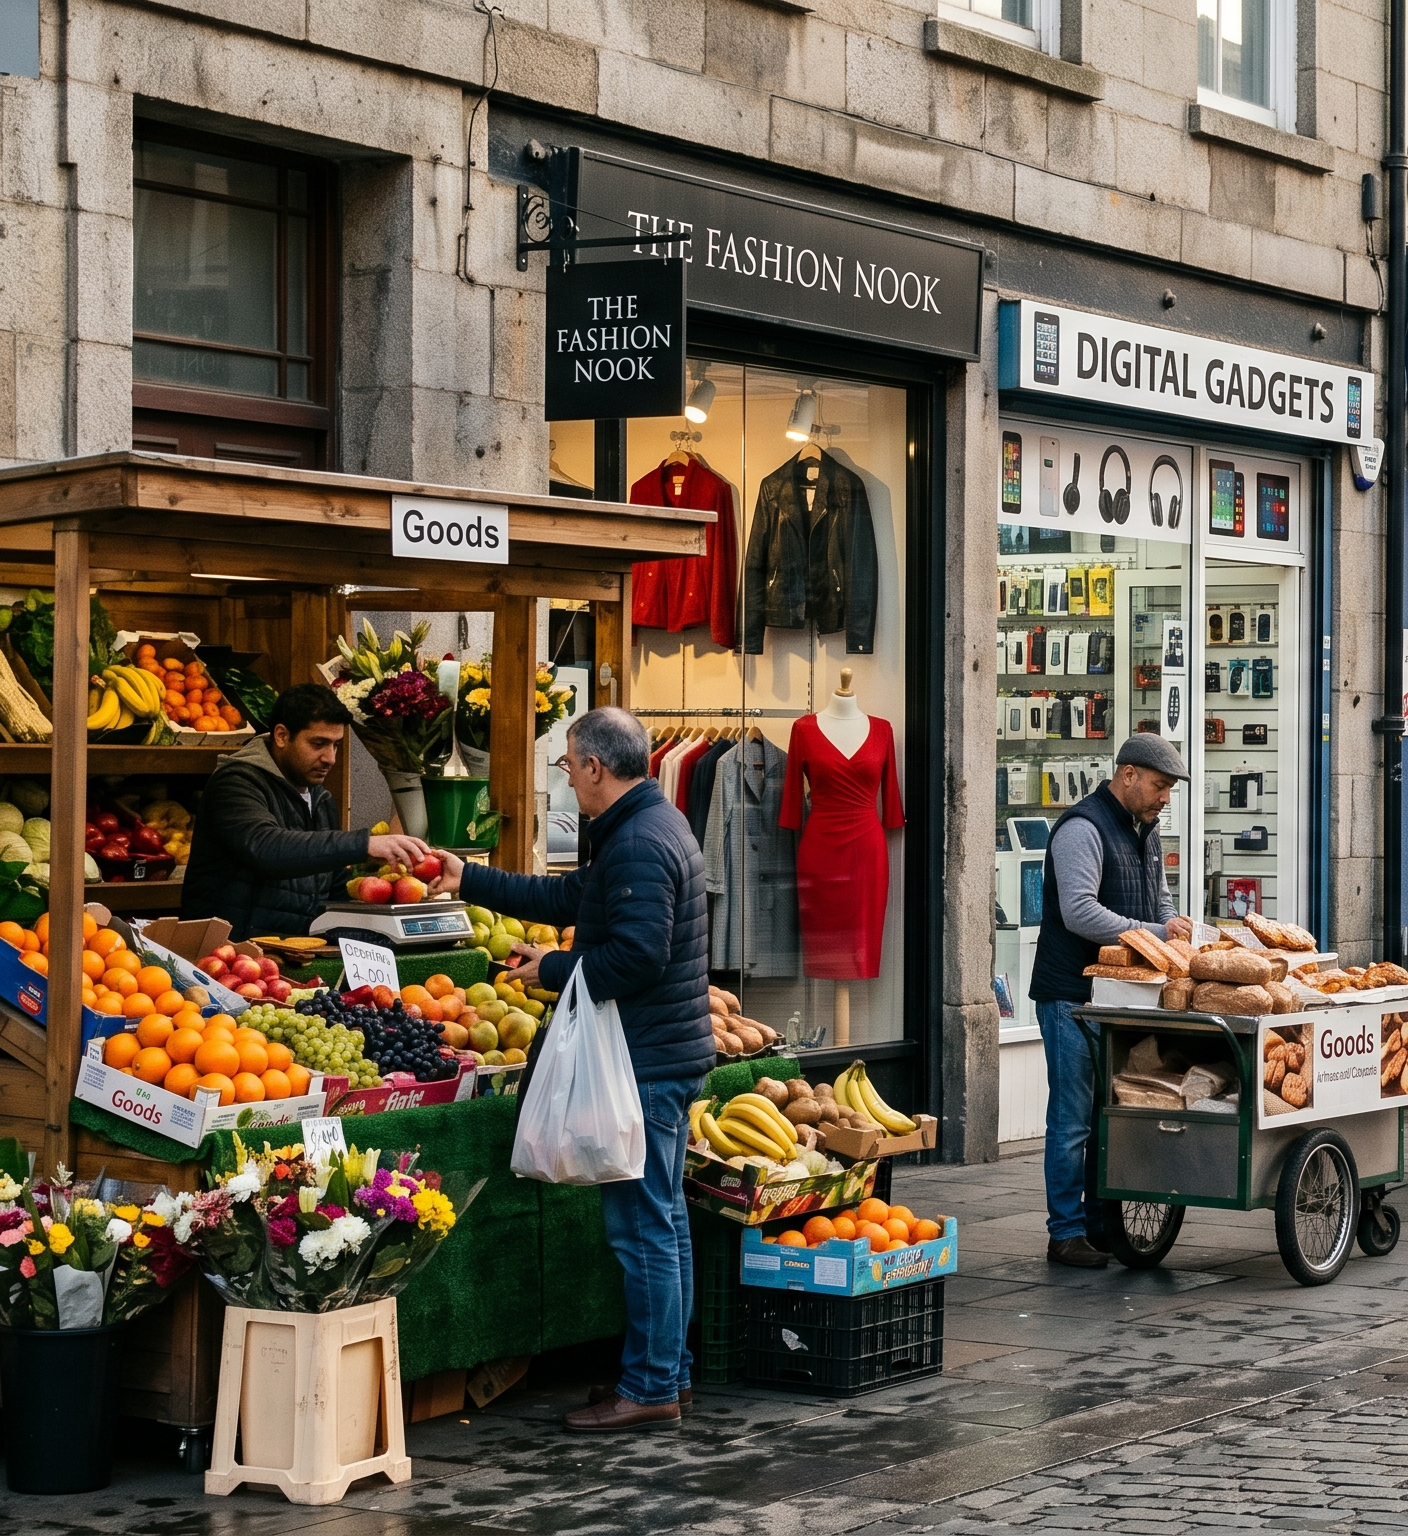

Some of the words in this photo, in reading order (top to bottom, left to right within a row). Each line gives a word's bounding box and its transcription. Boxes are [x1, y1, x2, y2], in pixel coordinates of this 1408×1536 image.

[627, 210, 693, 263] THE
[705, 227, 844, 294] FASHION
[853, 260, 942, 315] NOOK
[587, 295, 638, 320] THE
[557, 324, 672, 352] FASHION
[574, 356, 655, 383] NOOK
[1077, 331, 1197, 399] DIGITAL
[1204, 358, 1334, 424] GADGETS
[402, 509, 499, 549] Goods
[1320, 1024, 1374, 1059] Goods
[111, 1089, 163, 1125] Goods
